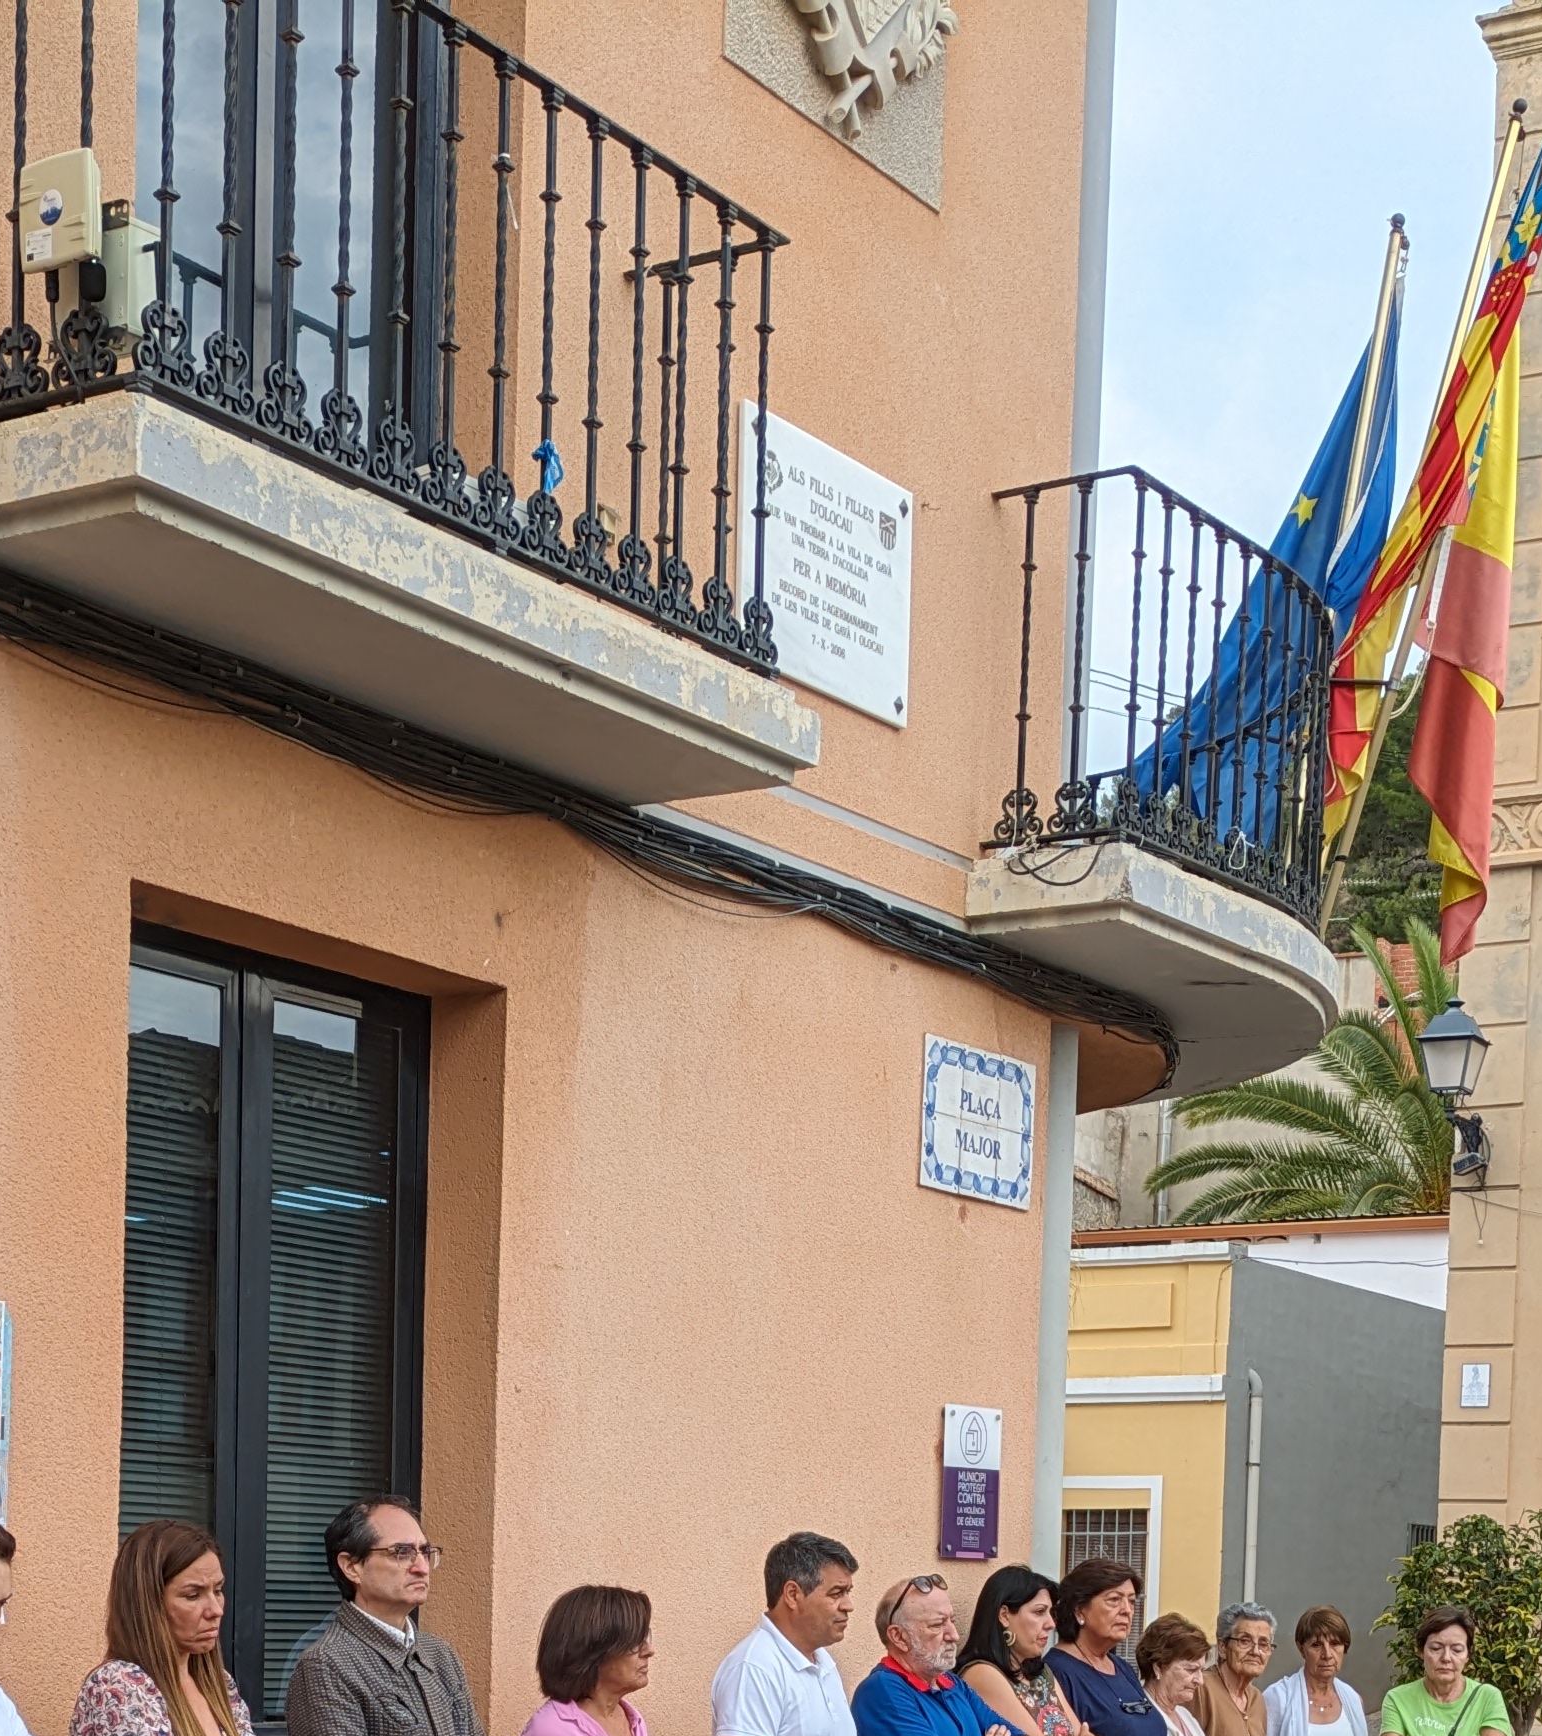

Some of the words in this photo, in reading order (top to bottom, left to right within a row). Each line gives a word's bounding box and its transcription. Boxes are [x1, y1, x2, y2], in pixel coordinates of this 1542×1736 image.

[787, 465, 806, 487] ALS
[809, 475, 834, 502] FILLS
[837, 491, 842, 507] I
[844, 495, 875, 524] FILLES
[810, 498, 853, 535] D'OLOCAU
[783, 510, 797, 528] VAN
[799, 518, 826, 545] TROBAR
[828, 534, 834, 548] A
[835, 537, 845, 554] LA
[846, 543, 862, 563] VILA
[863, 552, 874, 569] DE
[791, 531, 806, 550] UNA
[807, 539, 830, 562] TERRA
[832, 552, 869, 582] D'ACOLLIDA
[778, 578, 807, 602] RECORD
[809, 593, 820, 609] DE
[792, 557, 811, 580] PER
[814, 569, 822, 585] A
[825, 573, 867, 608] MEMÒRIA
[771, 591, 782, 607] DE
[783, 596, 798, 614] LES
[800, 603, 820, 625] VILES
[821, 615, 832, 631] DE
[858, 634, 885, 656] OLOCAU
[959, 1088, 1002, 1121] PLAÇA
[954, 1128, 1002, 1161] MAJOR
[957, 1470, 987, 1484] MUNICIPI
[957, 1482, 987, 1493] PROTEGIT
[957, 1492, 987, 1505] CONTRA
[956, 1516, 964, 1526] DE
